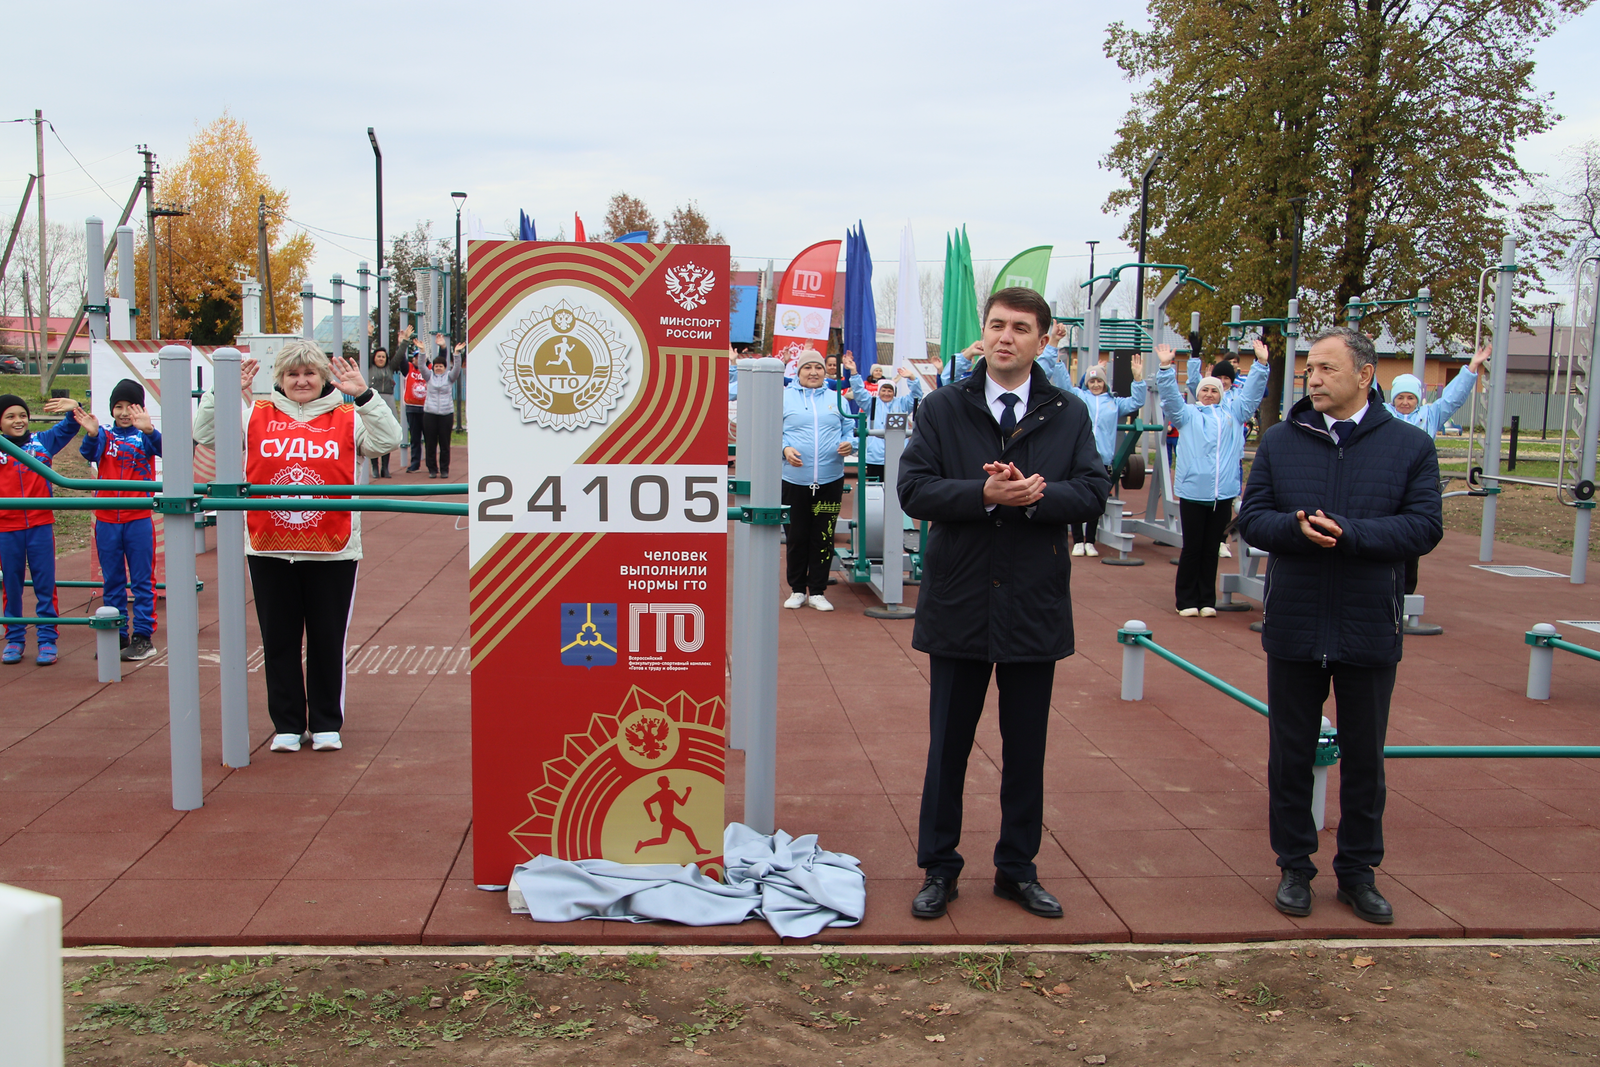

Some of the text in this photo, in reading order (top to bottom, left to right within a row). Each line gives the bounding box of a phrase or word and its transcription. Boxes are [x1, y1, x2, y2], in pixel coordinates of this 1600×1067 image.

[792, 269, 823, 291] ГТО
[659, 316, 722, 328] МИНСПОРТ
[666, 329, 712, 340] РОССИИ
[549, 376, 580, 390] ГТО
[260, 437, 340, 461] СУДЬЯ
[477, 474, 720, 523] 24105
[644, 551, 708, 561] человек
[620, 565, 707, 576] выполнили
[628, 579, 678, 593] нормы
[629, 603, 705, 653] ГТО
